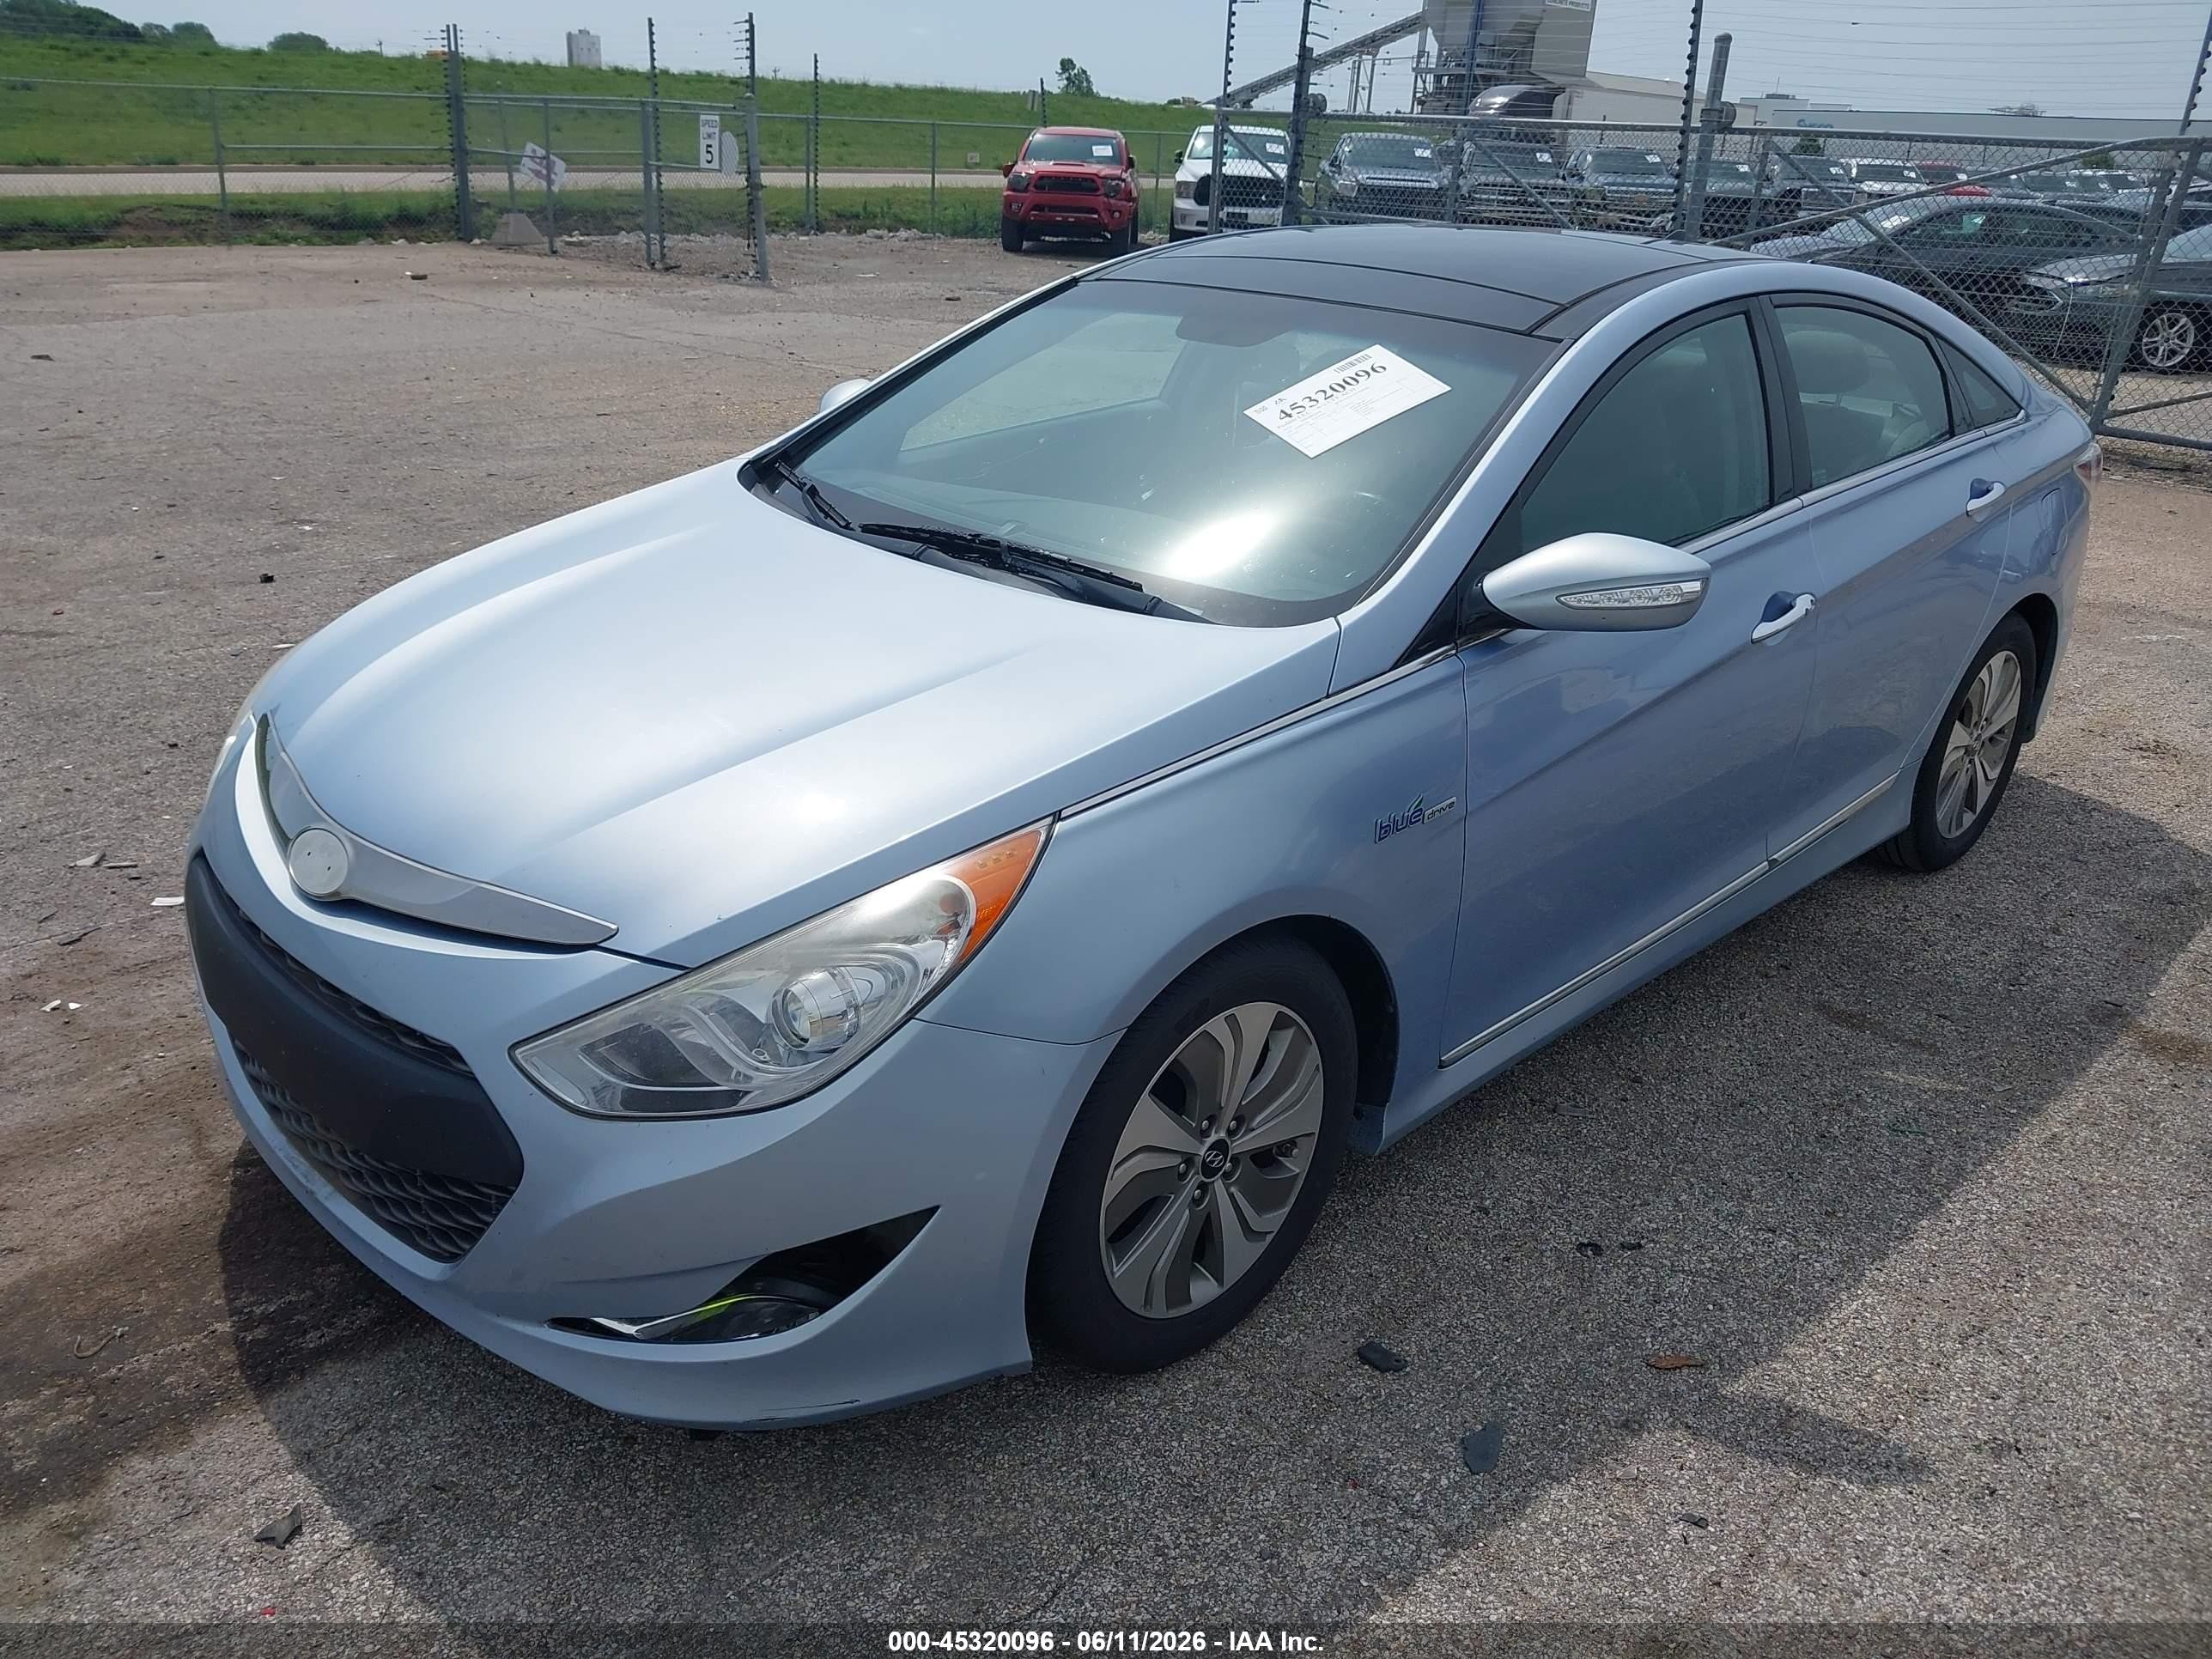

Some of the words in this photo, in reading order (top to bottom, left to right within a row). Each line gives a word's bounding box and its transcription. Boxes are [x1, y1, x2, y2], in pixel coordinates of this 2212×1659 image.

[701, 119, 718, 128] SPEED
[705, 143, 714, 164] 5
[1279, 362, 1388, 421] 45320096
[1374, 804, 1425, 844] blue
[1426, 800, 1456, 821] drive
